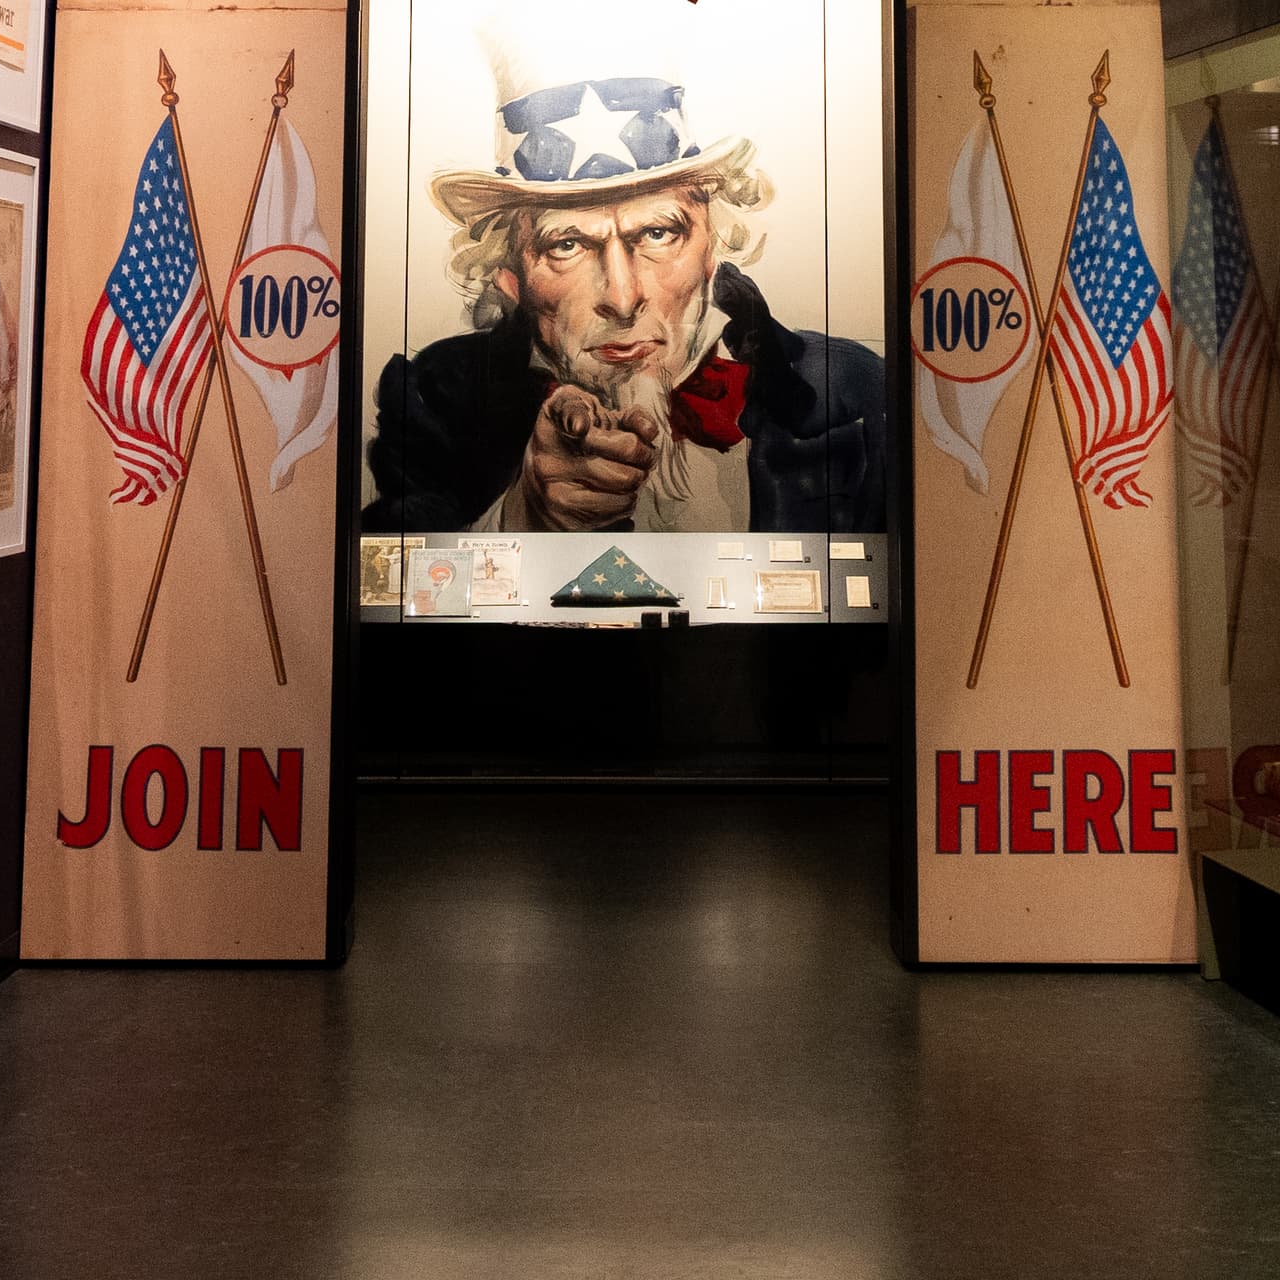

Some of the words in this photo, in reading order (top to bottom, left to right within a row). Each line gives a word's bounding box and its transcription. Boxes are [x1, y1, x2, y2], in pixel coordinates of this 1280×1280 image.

[239, 274, 340, 340] 100%
[919, 287, 1023, 353] 100%
[56, 743, 305, 852] JOIN
[934, 748, 1179, 855] HERE
